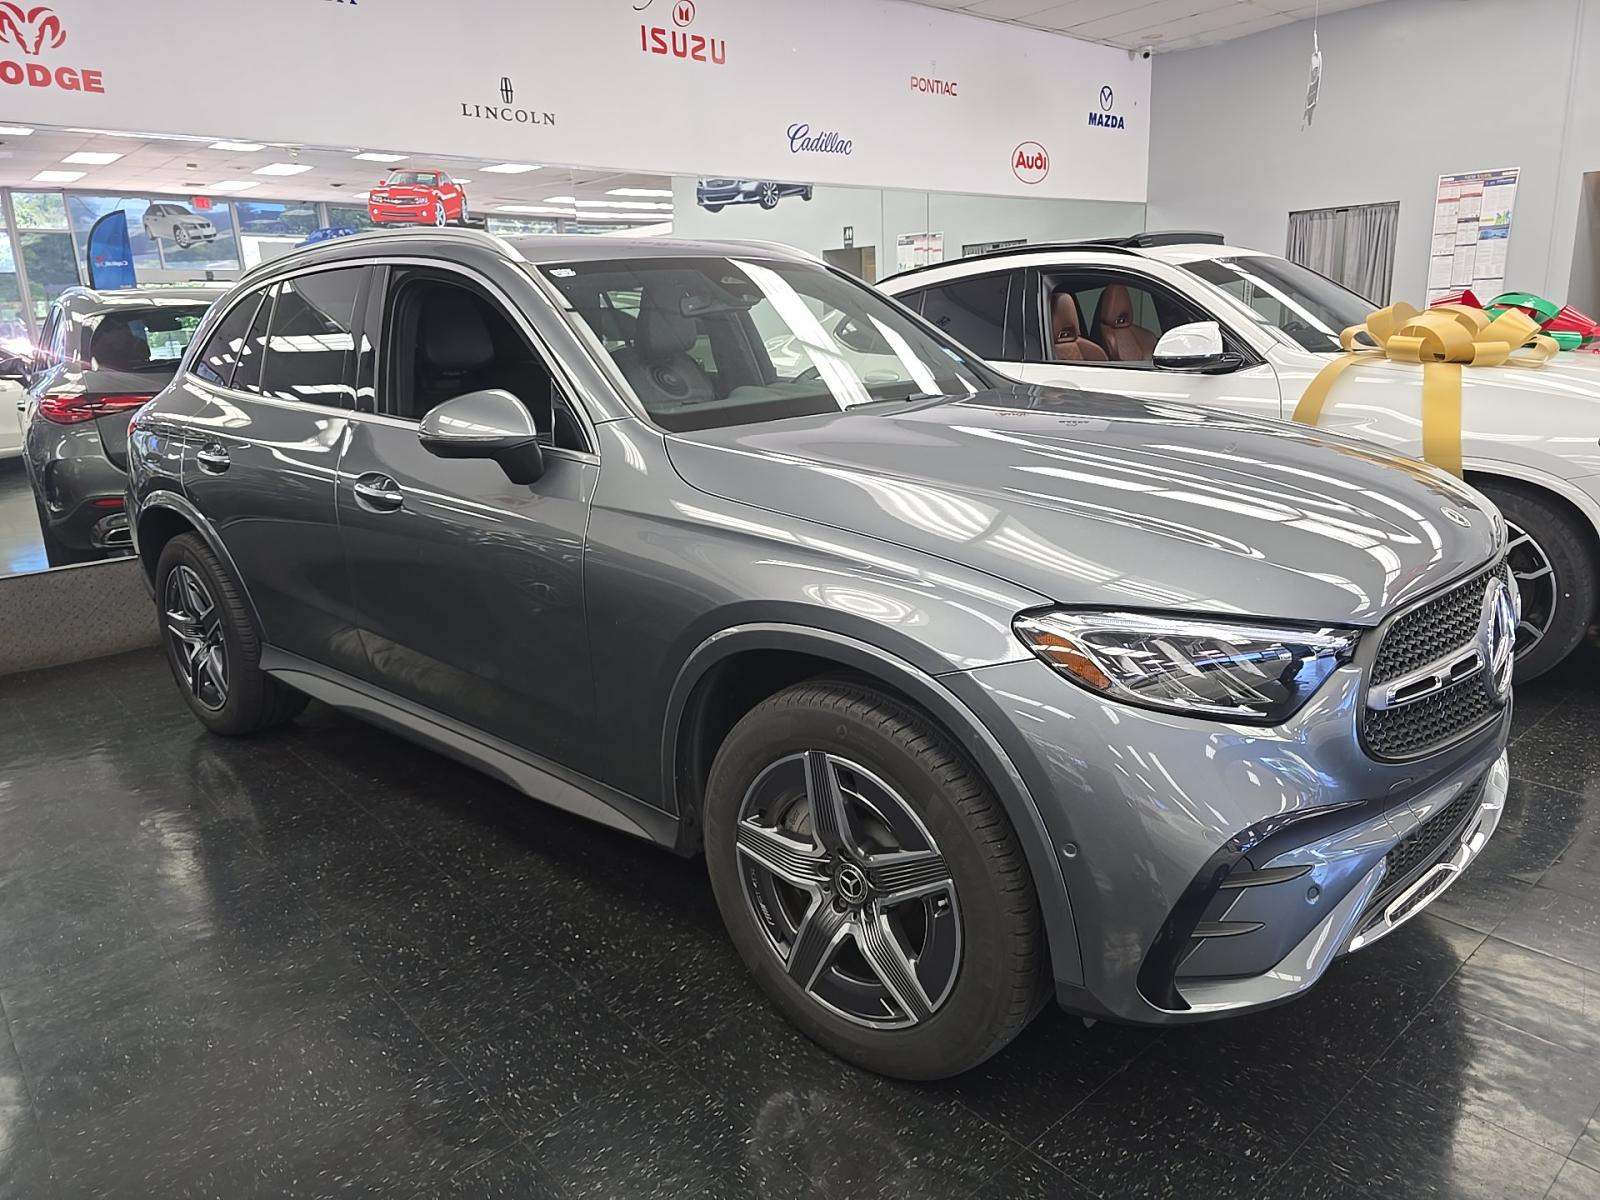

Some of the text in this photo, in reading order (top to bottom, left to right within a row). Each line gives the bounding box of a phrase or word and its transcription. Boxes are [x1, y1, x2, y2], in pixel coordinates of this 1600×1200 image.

[640, 25, 726, 65] ISUZU
[0, 60, 105, 94] ODGE
[910, 76, 958, 97] PONTIAC
[461, 102, 556, 126] LINCOLN
[1088, 112, 1125, 130] MAZDA
[787, 123, 852, 155] Cadillac
[1015, 150, 1047, 171] Audi
